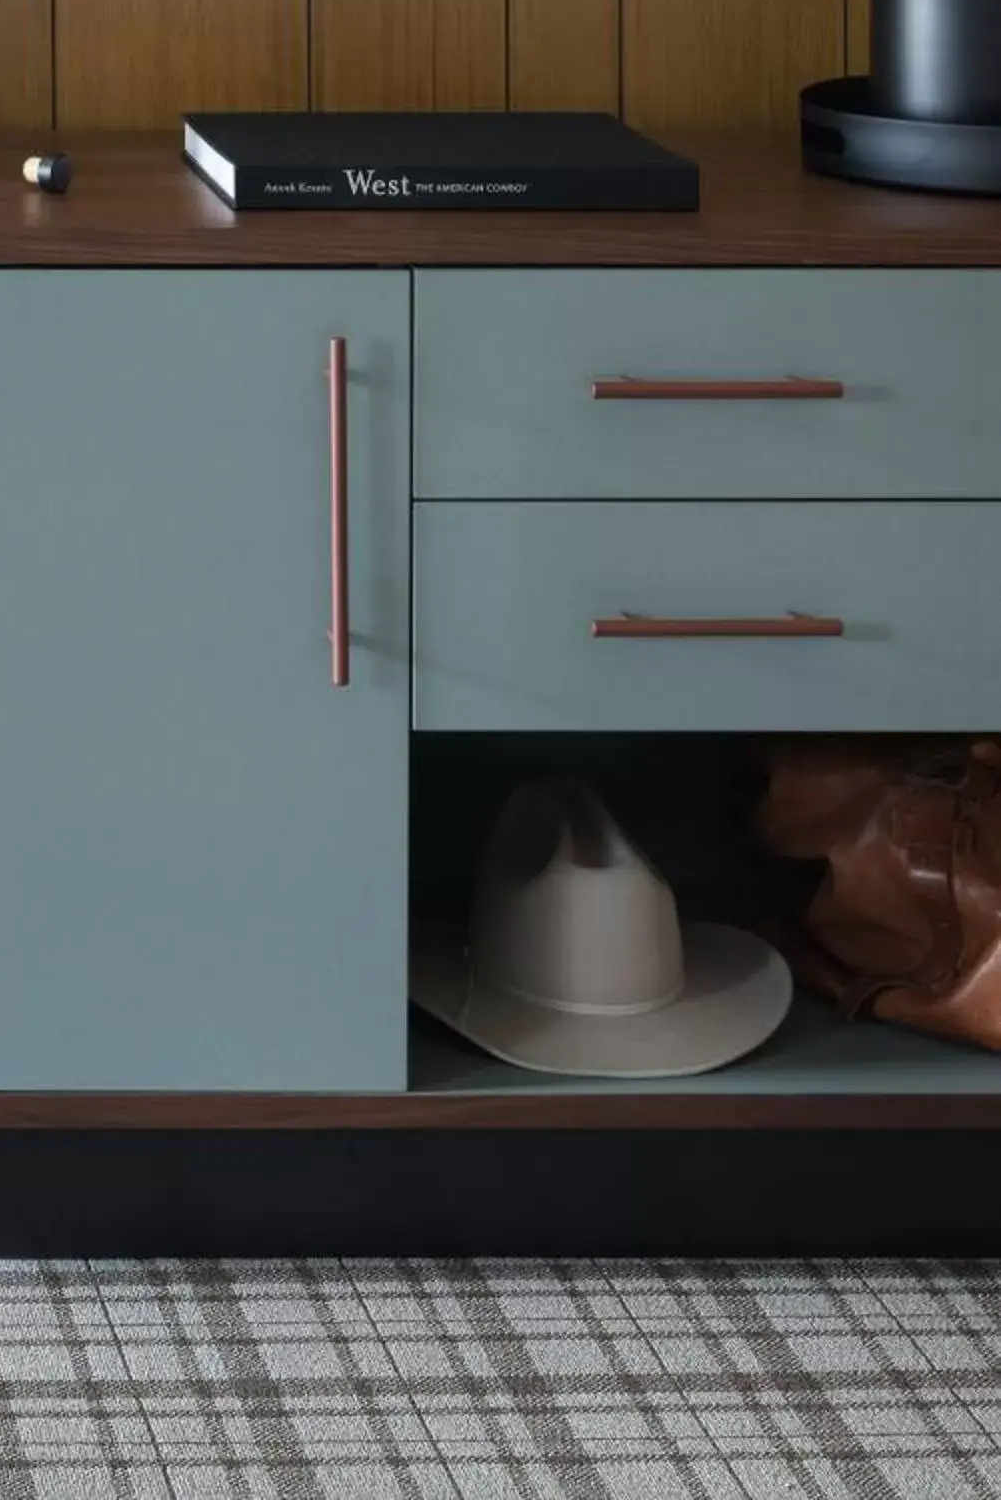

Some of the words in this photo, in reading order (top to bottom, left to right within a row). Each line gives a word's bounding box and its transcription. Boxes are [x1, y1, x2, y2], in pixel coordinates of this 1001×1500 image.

[342, 169, 411, 196] West
[416, 182, 434, 193] THE
[436, 182, 484, 193] AMERICAN
[486, 182, 528, 193] COWBOY
